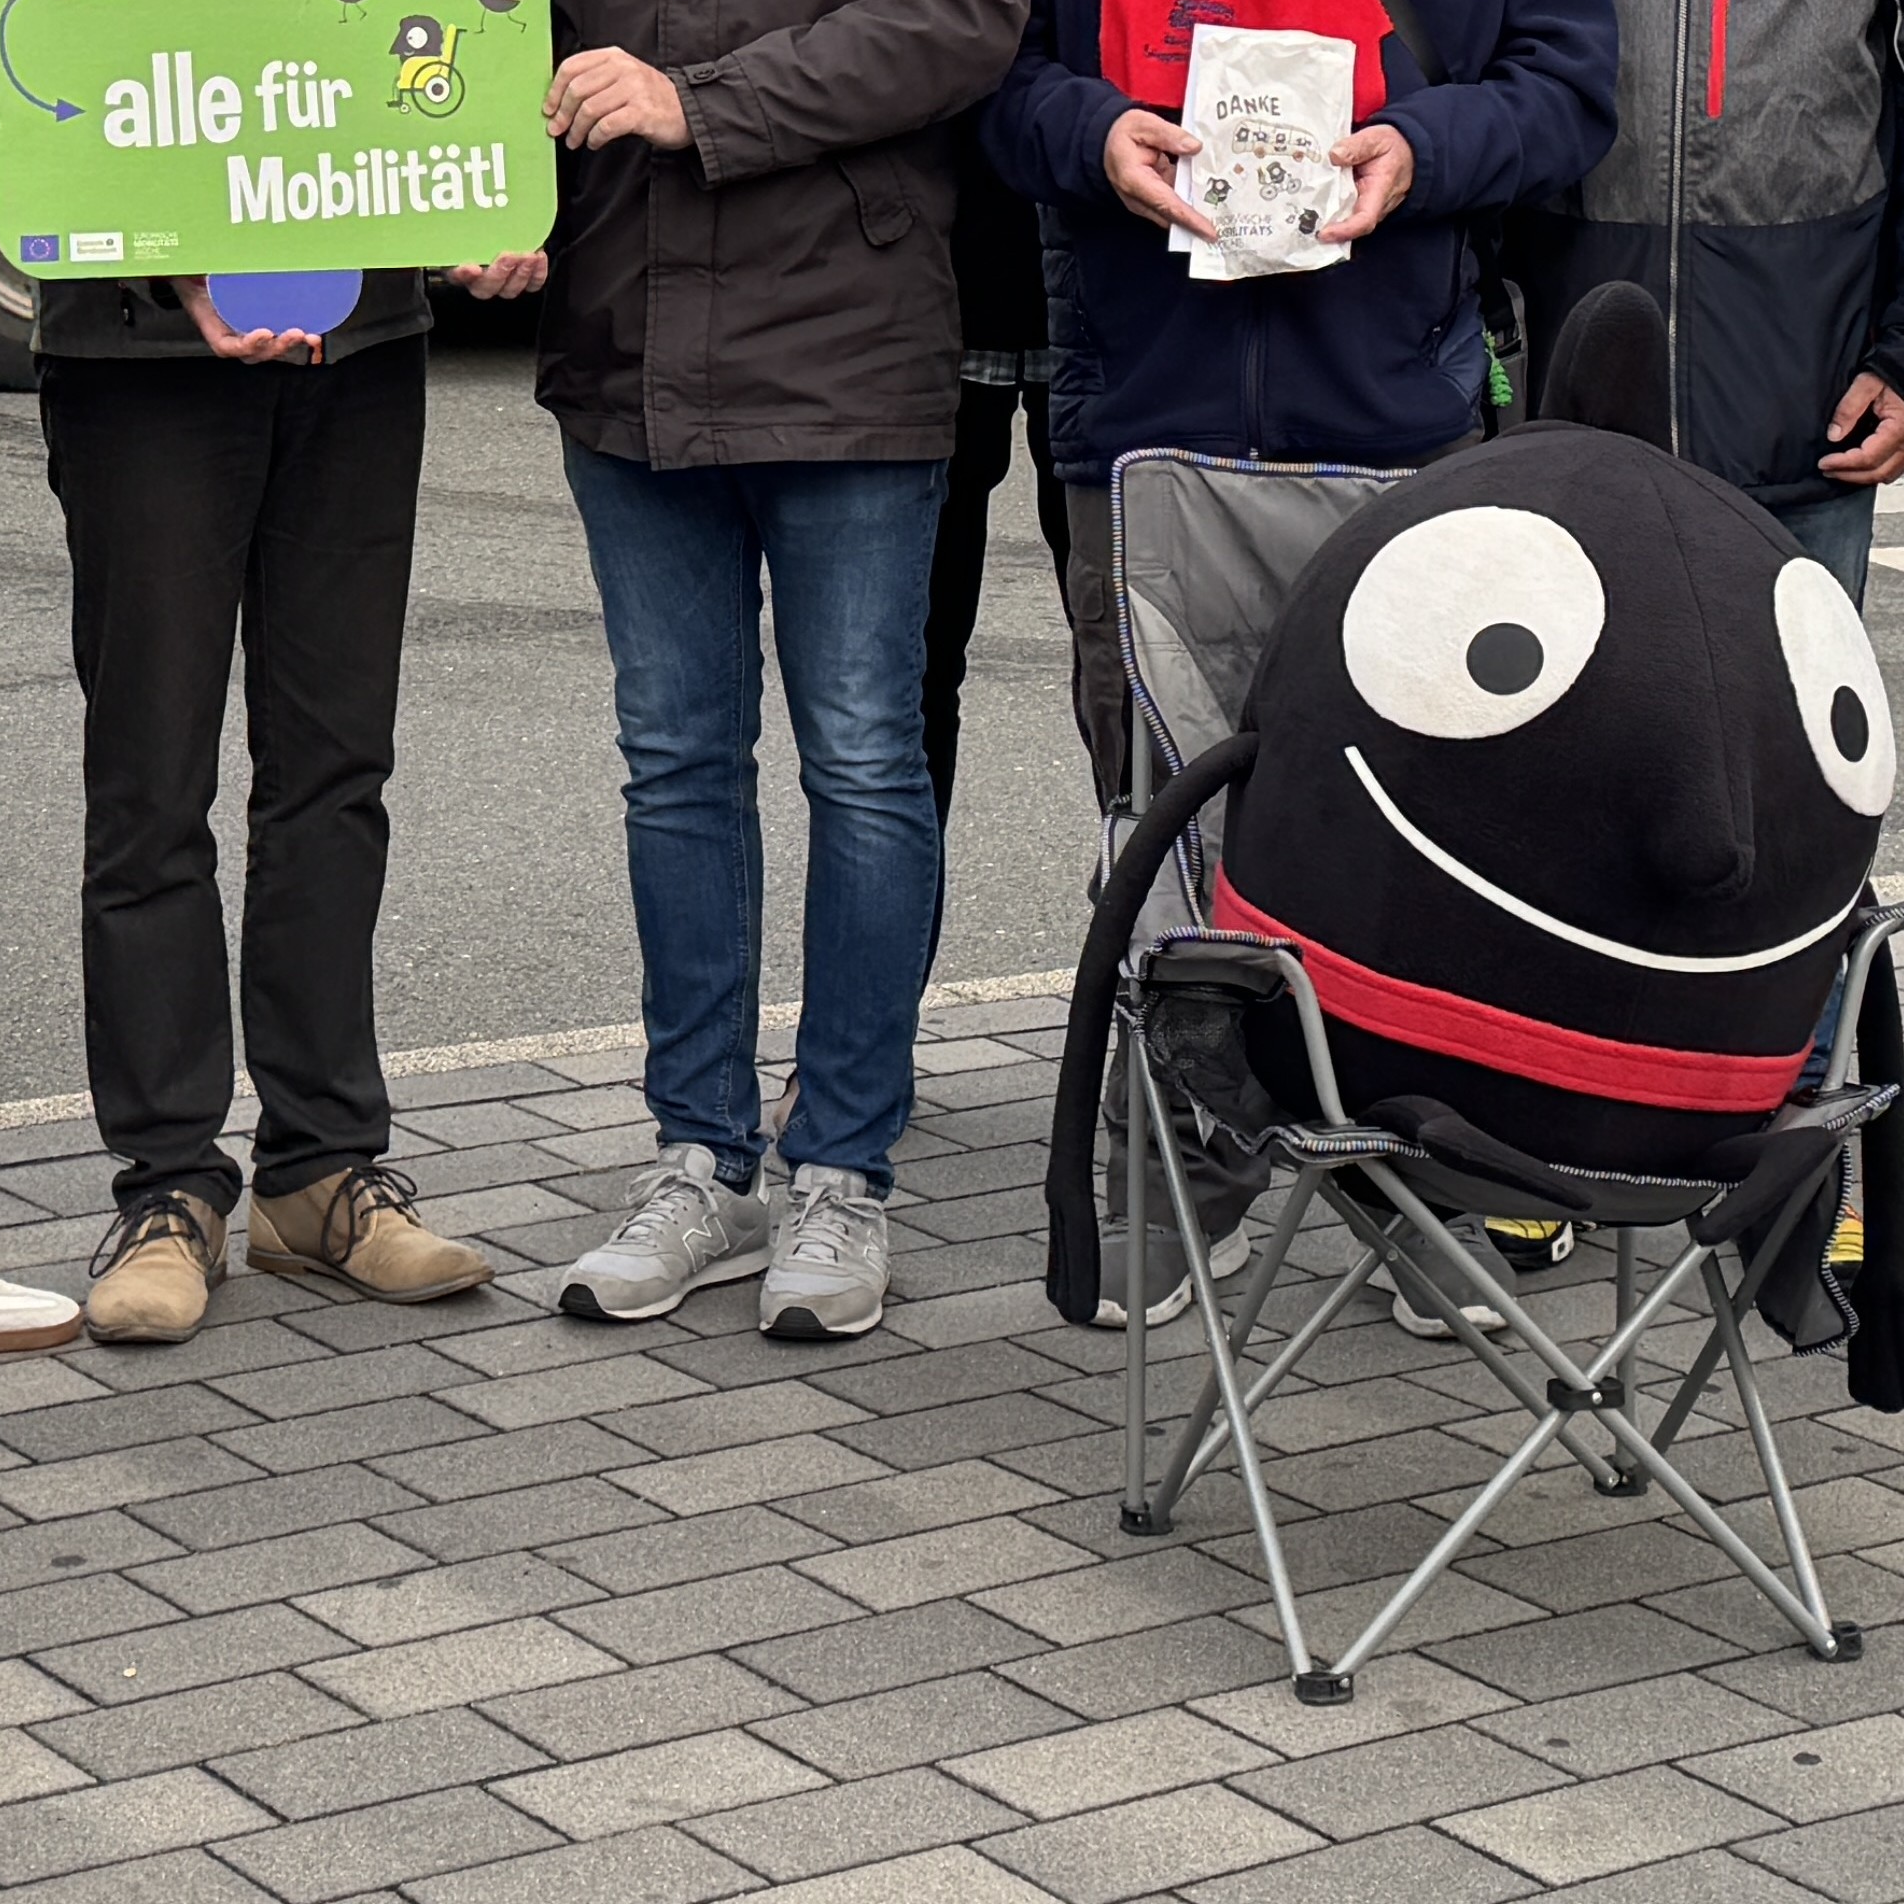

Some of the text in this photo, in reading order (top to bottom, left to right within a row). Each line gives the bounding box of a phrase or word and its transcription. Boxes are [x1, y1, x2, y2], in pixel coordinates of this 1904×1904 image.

[102, 51, 354, 148] alle für
[1216, 94, 1281, 121] DANKE
[226, 142, 510, 225] Mobilität!
